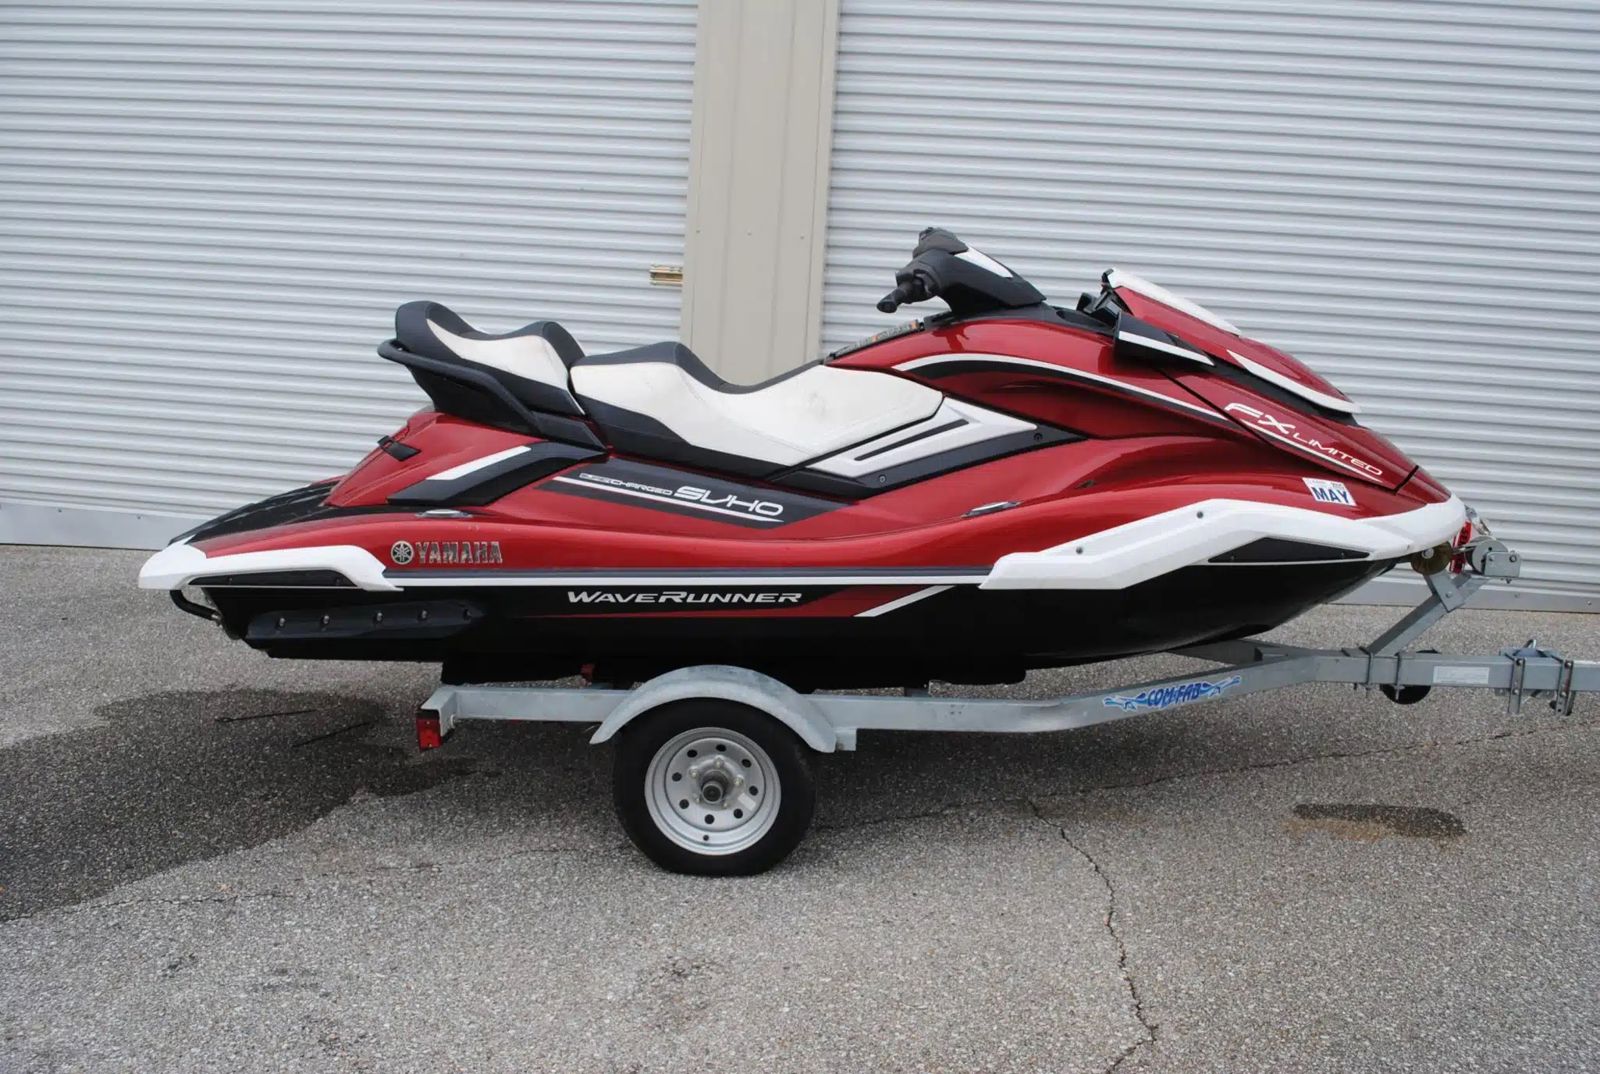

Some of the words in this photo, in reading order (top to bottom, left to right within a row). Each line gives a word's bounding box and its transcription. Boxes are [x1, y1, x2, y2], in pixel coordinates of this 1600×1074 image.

[1224, 402, 1296, 435] FX
[1293, 432, 1384, 476] LIMITED
[1311, 486, 1349, 504] MAY
[415, 541, 503, 564] YAMAHA
[567, 591, 802, 604] WAVERUNNER
